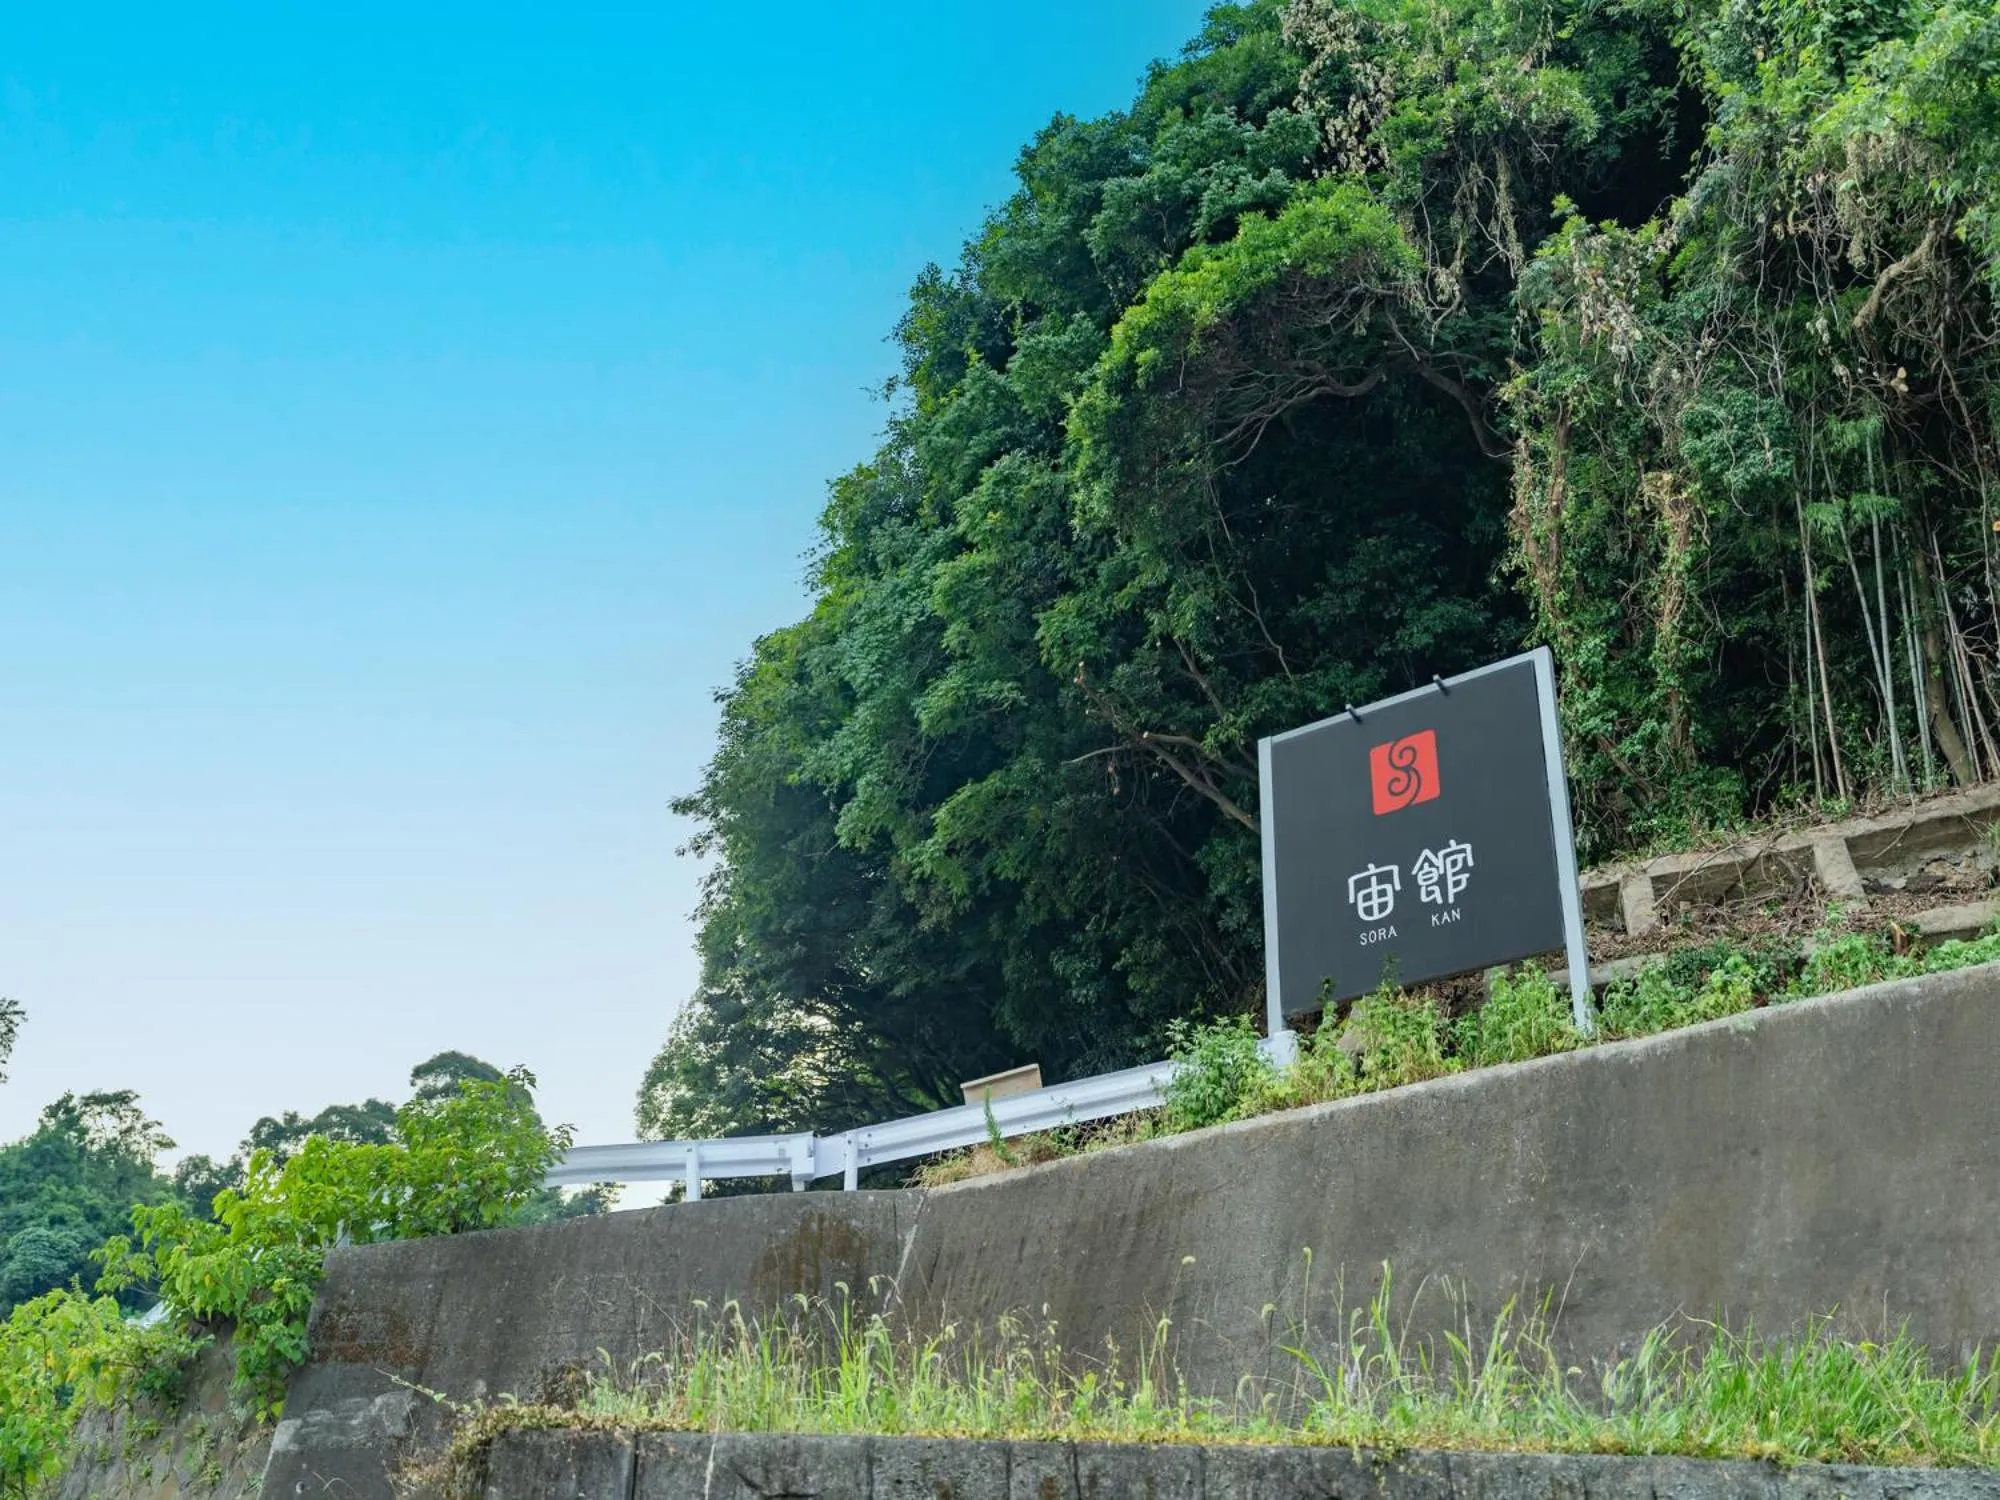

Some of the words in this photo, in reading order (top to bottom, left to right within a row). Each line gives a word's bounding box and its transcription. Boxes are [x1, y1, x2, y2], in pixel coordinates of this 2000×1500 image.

[1348, 839, 1474, 922] 宙館
[1359, 925, 1398, 946] SORA
[1431, 907, 1461, 927] KAN
